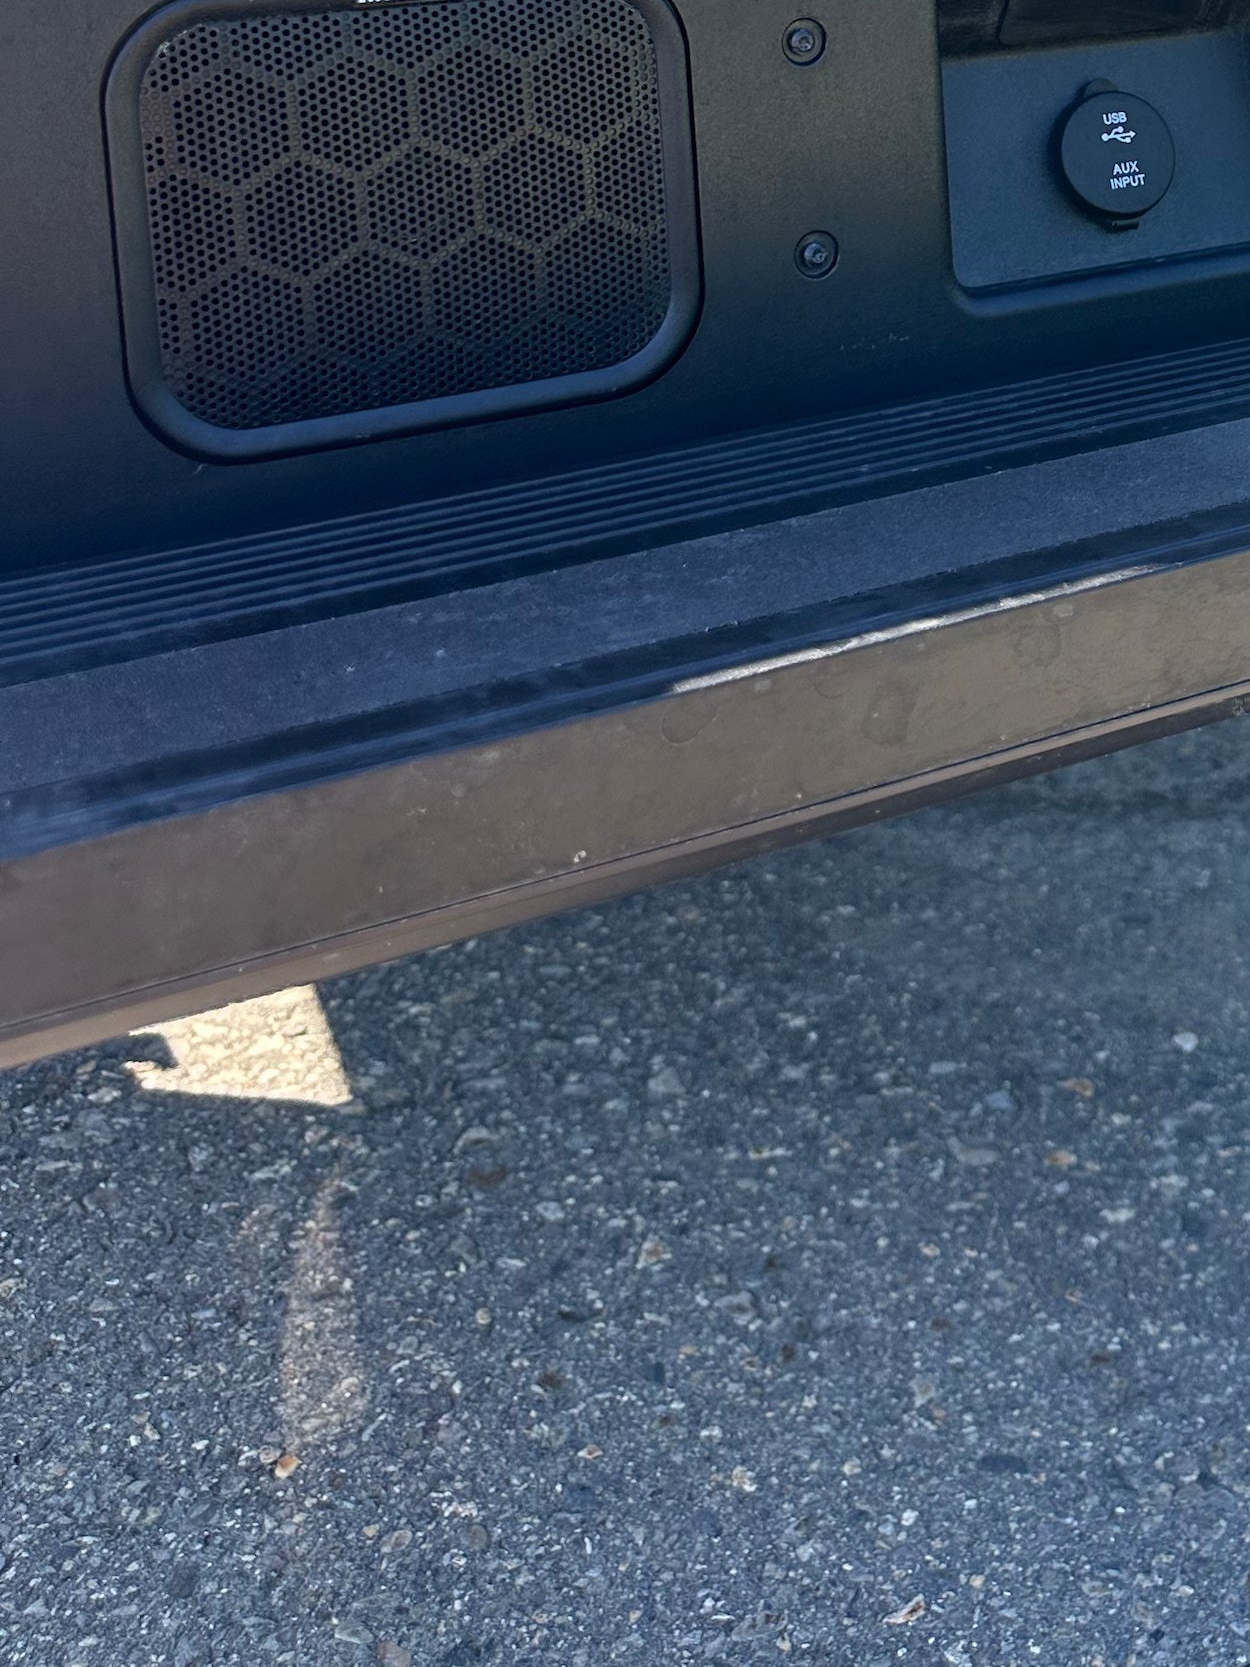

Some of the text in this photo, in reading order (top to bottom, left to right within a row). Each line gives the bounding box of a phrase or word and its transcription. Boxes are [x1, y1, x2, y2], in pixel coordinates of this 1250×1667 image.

[1102, 111, 1128, 125] USB
[1112, 160, 1140, 176] AUX
[1109, 173, 1146, 190] INPUT
